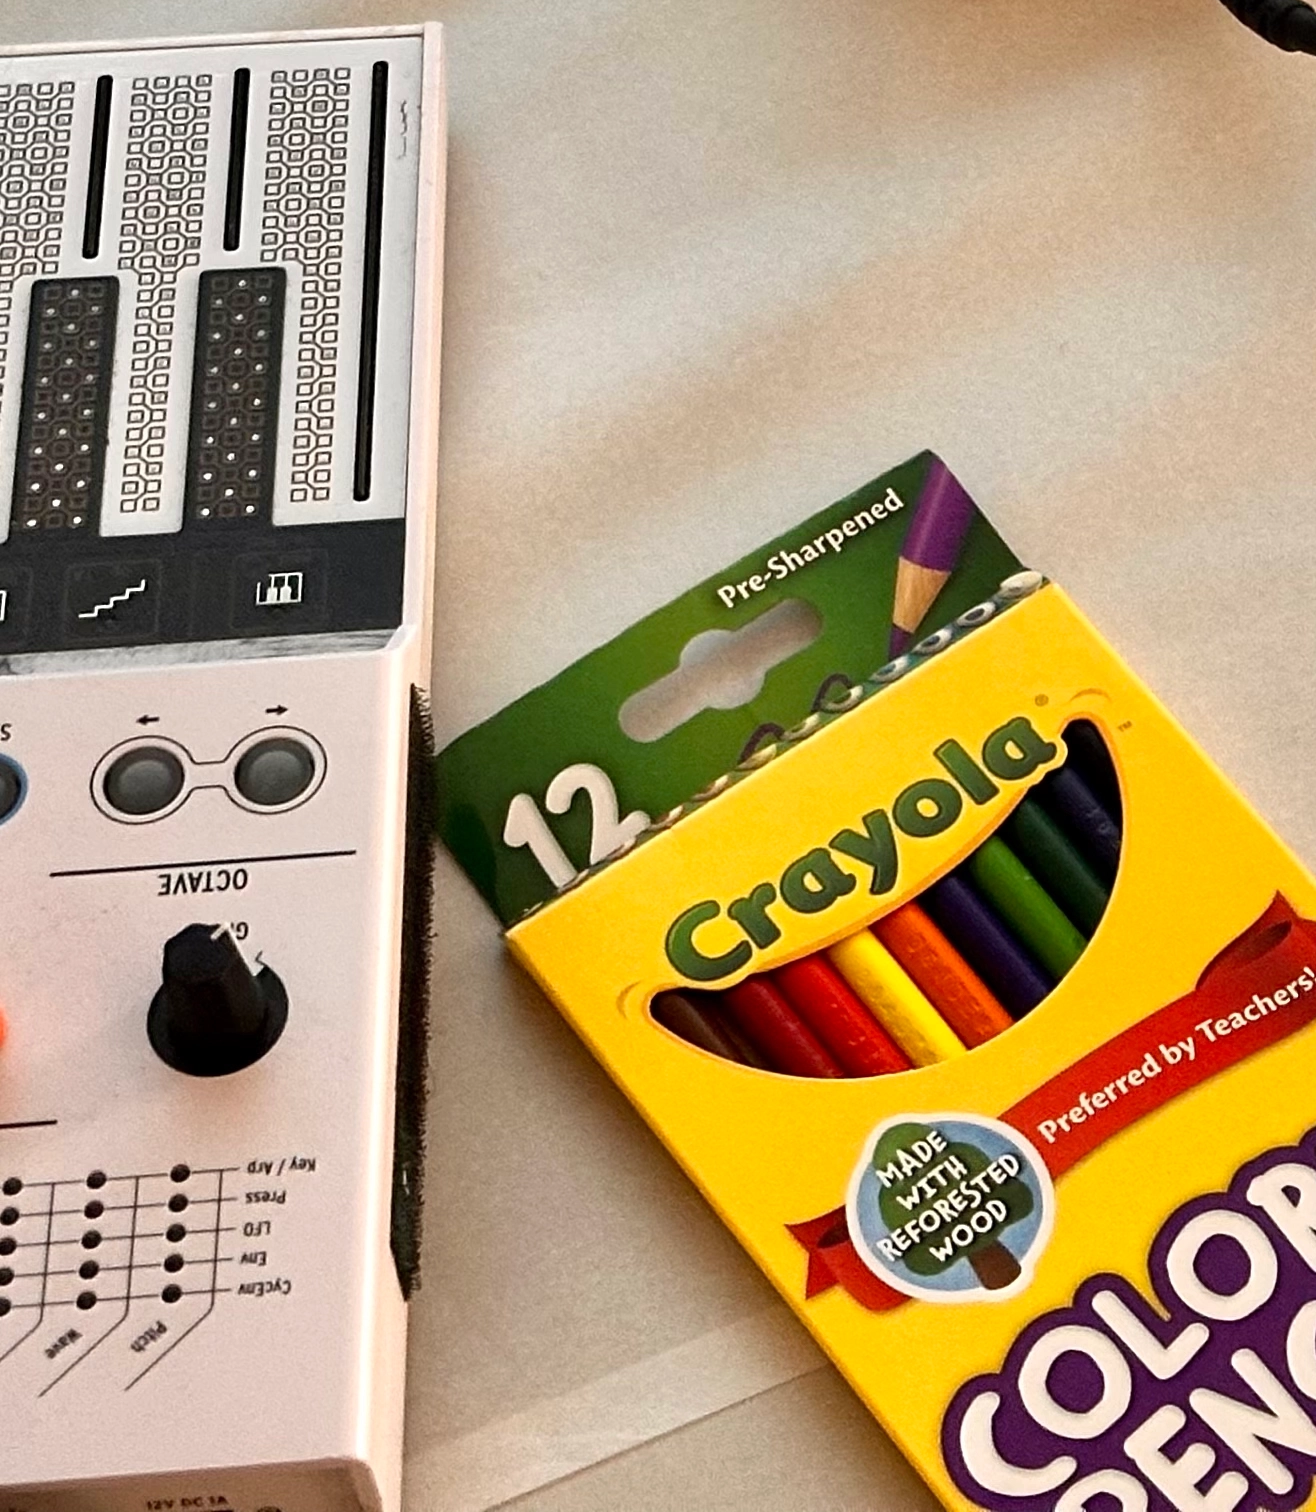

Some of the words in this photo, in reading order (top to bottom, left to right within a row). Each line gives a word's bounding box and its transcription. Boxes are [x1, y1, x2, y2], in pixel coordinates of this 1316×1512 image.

[716, 487, 905, 610] Pre-Sharpened
[503, 761, 651, 890] 12
[664, 716, 1058, 982] Crayola
[157, 868, 248, 896] OCTAVE
[1036, 1053, 1163, 1147] Preferred
[1159, 1035, 1199, 1075] by
[247, 1161, 272, 1174] Arp
[287, 1156, 316, 1172] Key
[876, 1130, 949, 1189] MADE
[245, 1189, 286, 1204] Press
[895, 1155, 967, 1211] WITH
[877, 1152, 1022, 1264] REFORESTED
[243, 1220, 270, 1236] LFO
[927, 1201, 1009, 1266] WOOD
[239, 1251, 267, 1266] Env
[238, 1279, 292, 1297] CycEnv
[44, 1328, 83, 1359] Wave
[130, 1320, 168, 1353] Pitch
[146, 1496, 175, 1511] 12V
[180, 1495, 205, 1509] DC
